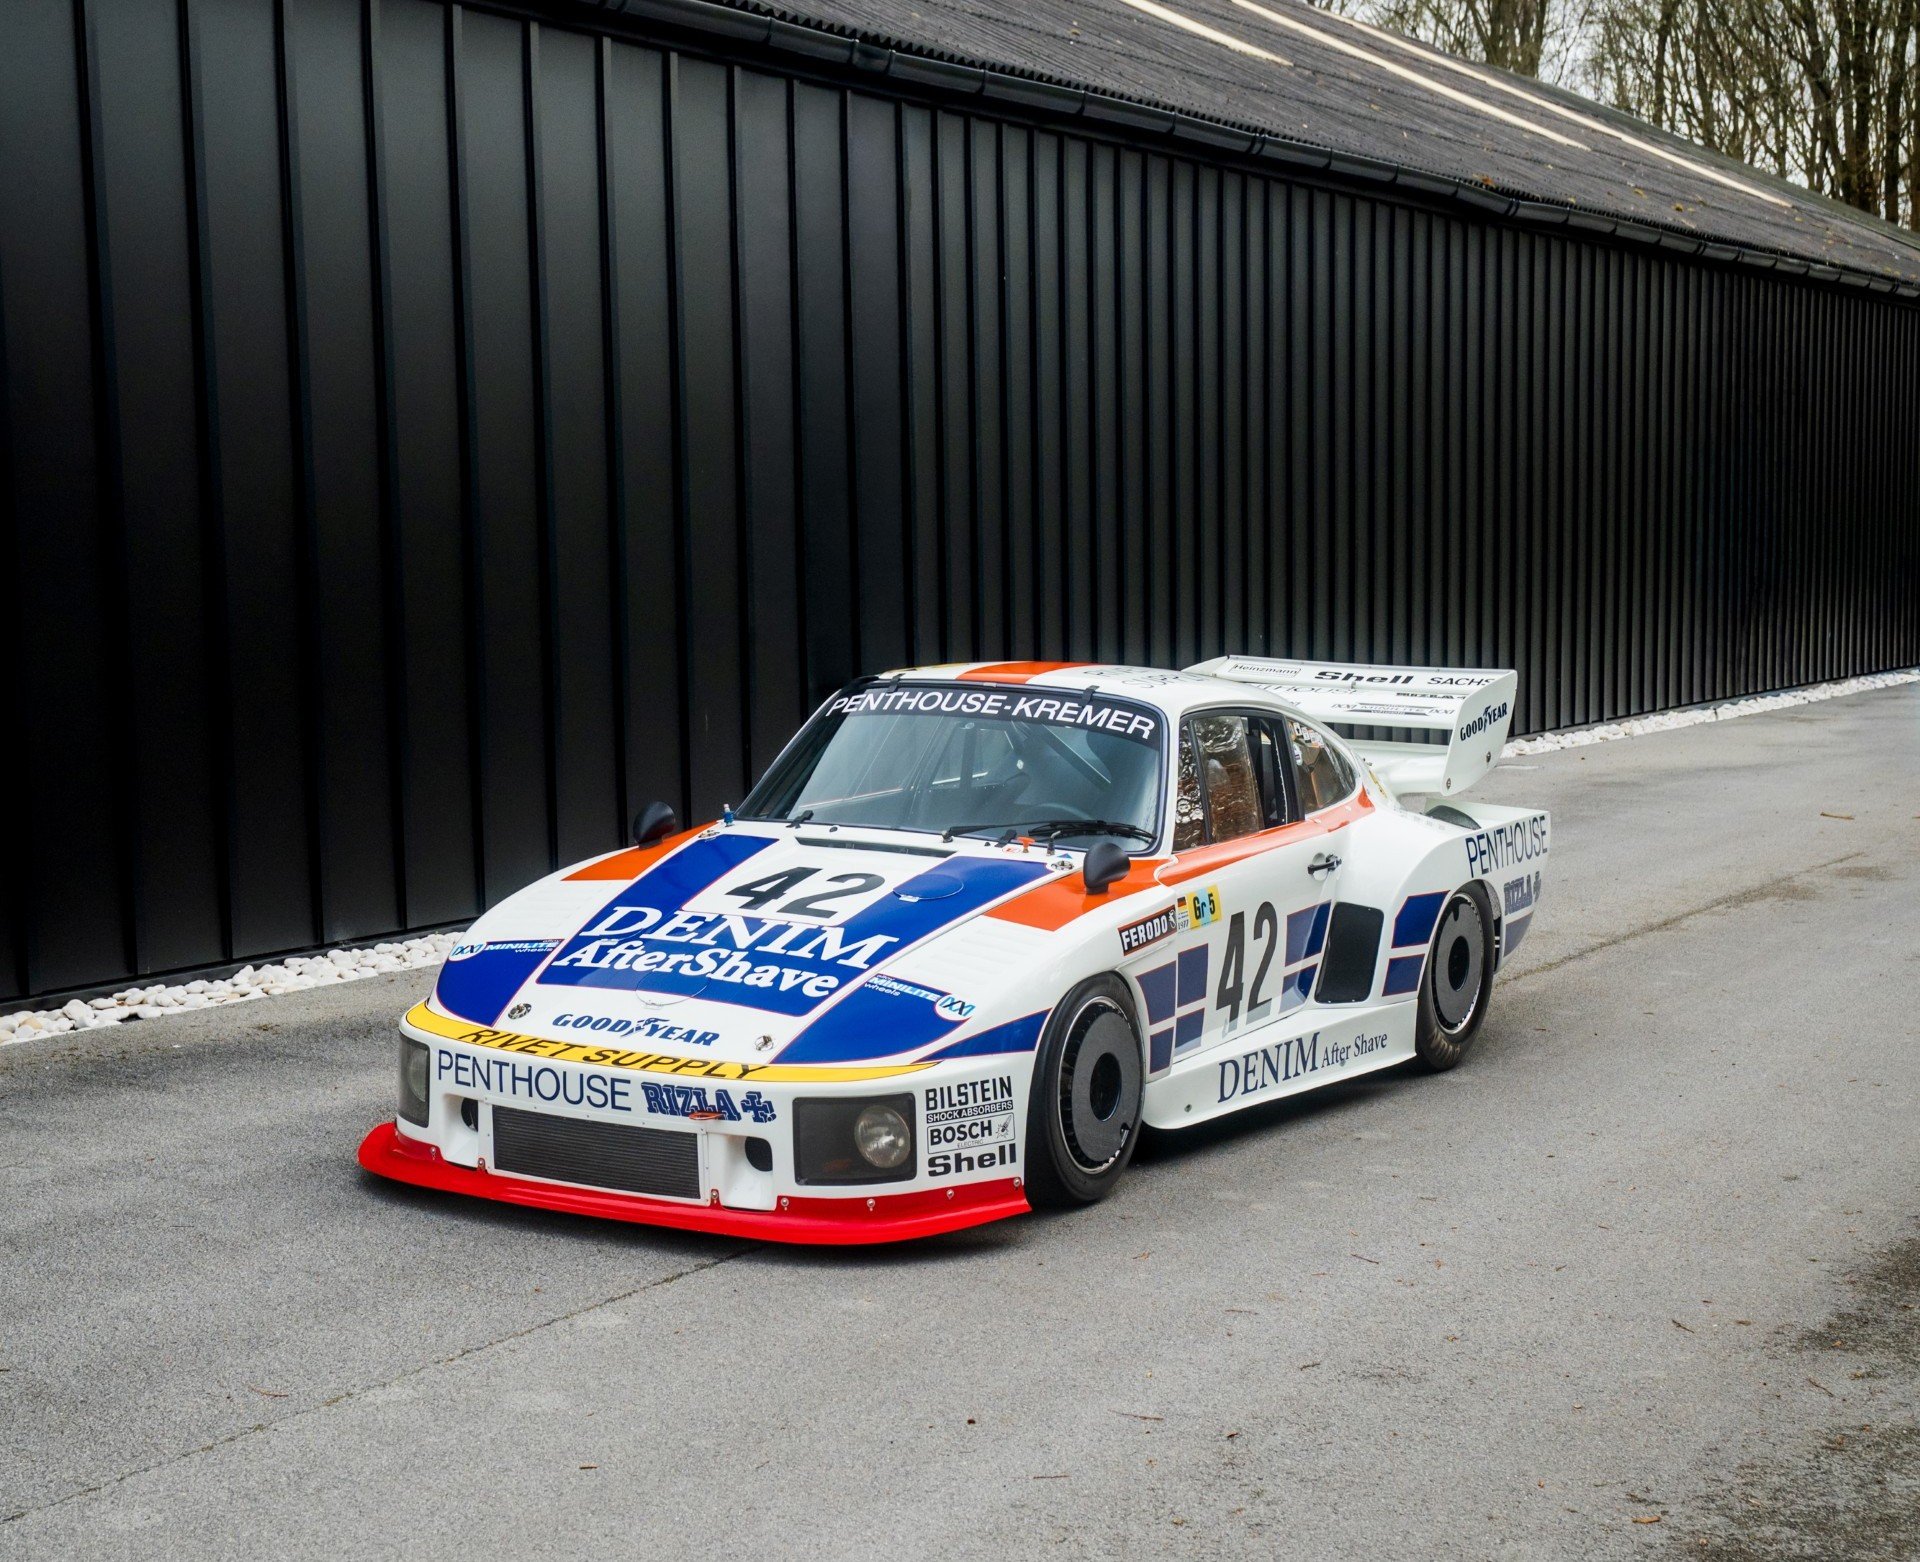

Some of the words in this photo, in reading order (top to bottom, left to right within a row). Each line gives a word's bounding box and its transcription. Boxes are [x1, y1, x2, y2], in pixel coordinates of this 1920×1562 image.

[1234, 664, 1298, 675] Heinzmann
[1314, 671, 1414, 684] Shell
[825, 691, 1156, 740] PENTHOUSE-KREMER
[1460, 702, 1507, 742] GOODYEAR
[1465, 815, 1547, 878] PENTHOUSE
[725, 866, 886, 920] 42
[1193, 896, 1206, 920] Gr
[1208, 893, 1215, 915] 5
[484, 942, 560, 951] MINILITE
[578, 905, 899, 970] DENIM
[1121, 915, 1168, 951] FERODO
[1215, 901, 1278, 1034] 42
[864, 983, 901, 997] wheels
[869, 977, 942, 1003] MINILITE
[552, 1013, 720, 1046] GOODYEAR
[458, 1028, 587, 1058] RIVET
[582, 1049, 768, 1080] SUPPLY
[1217, 1032, 1320, 1103] DENIM
[1321, 1042, 1351, 1069] After
[1353, 1033, 1388, 1057] Shave
[438, 1049, 632, 1112] PENTHOUSE
[925, 1075, 1012, 1112] BILSTEIN
[640, 1082, 742, 1122] RIZLA
[927, 1109, 960, 1123] SHOCK
[960, 1100, 1013, 1119] ABSORBERS
[929, 1119, 992, 1146] BOSCH
[927, 1142, 1016, 1178] Shell
